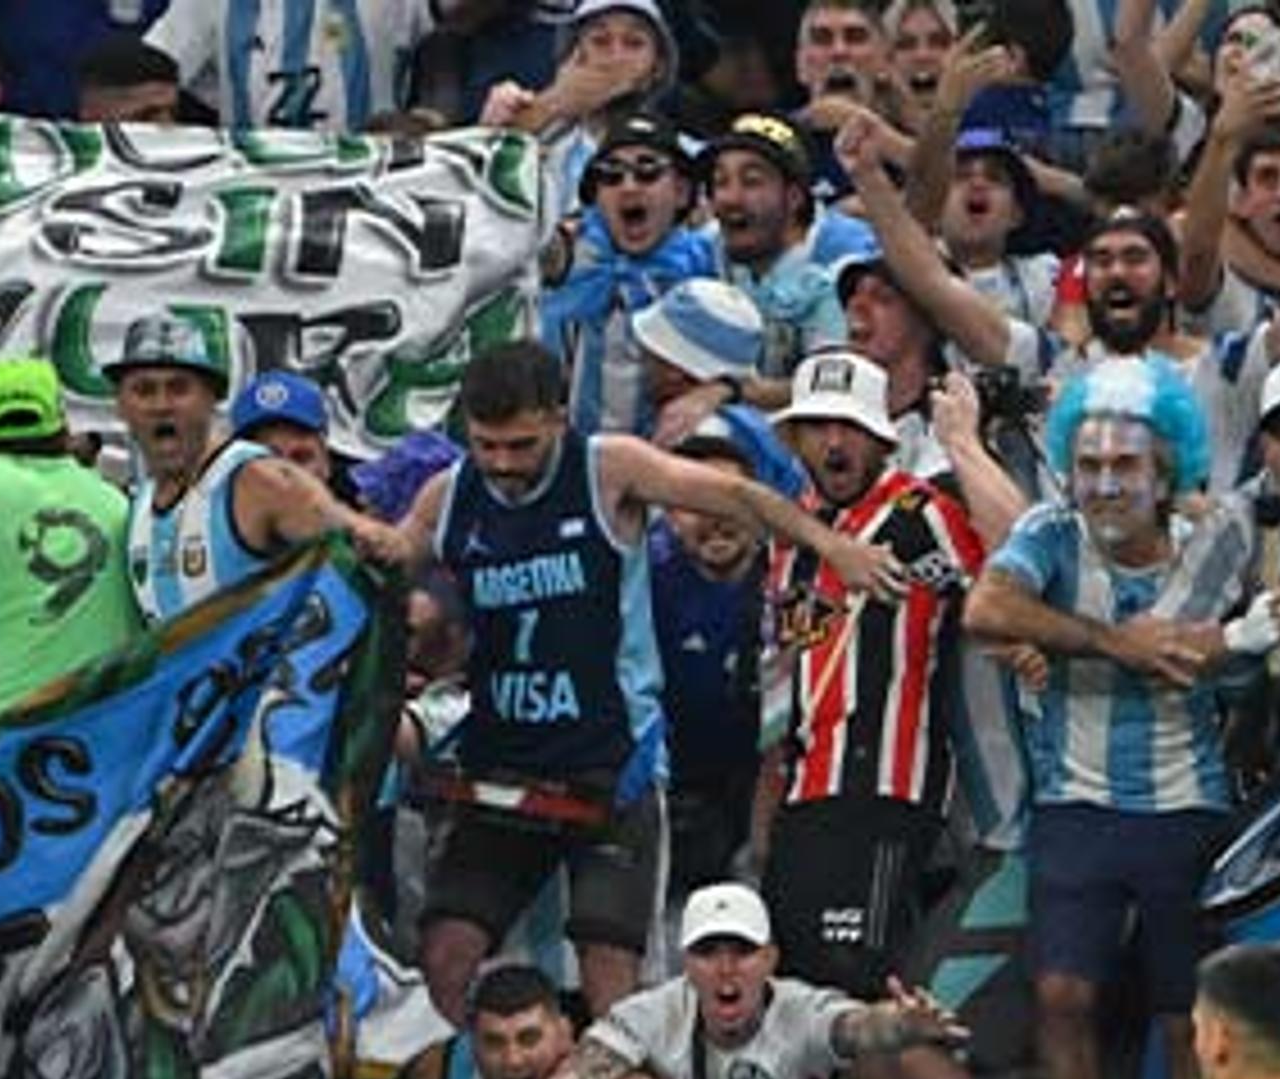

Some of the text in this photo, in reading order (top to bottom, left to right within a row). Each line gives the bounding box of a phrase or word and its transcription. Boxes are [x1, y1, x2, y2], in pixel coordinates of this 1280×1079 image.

[266, 68, 328, 128] 22
[34, 177, 467, 276] SIN
[19, 507, 111, 624] 9
[491, 670, 581, 722] VISA
